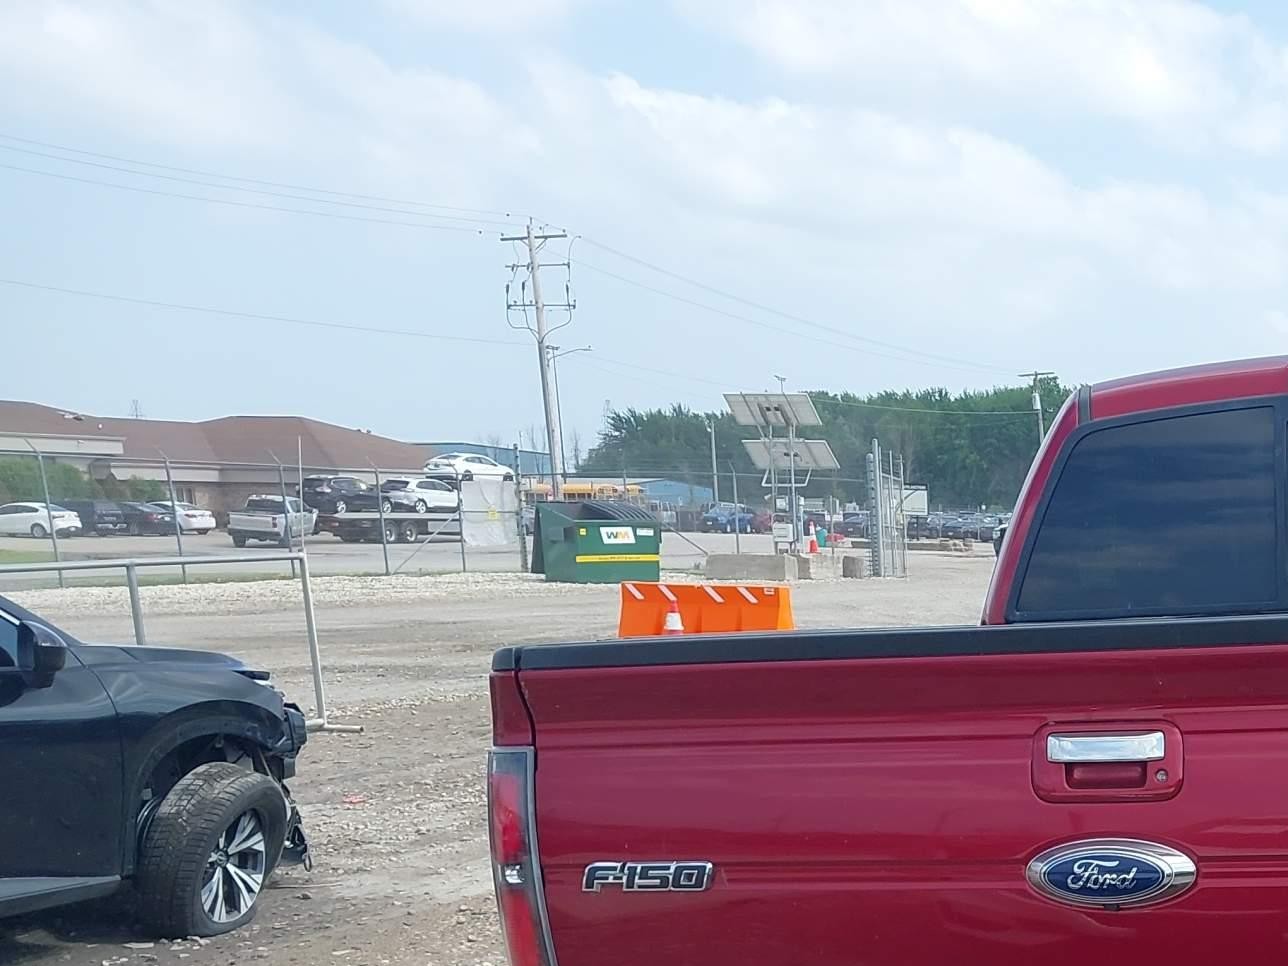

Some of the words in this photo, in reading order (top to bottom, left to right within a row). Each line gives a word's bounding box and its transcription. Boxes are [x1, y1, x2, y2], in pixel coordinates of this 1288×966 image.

[605, 530, 630, 540] WM
[582, 861, 713, 892] F-150
[1066, 859, 1138, 889] Ford
